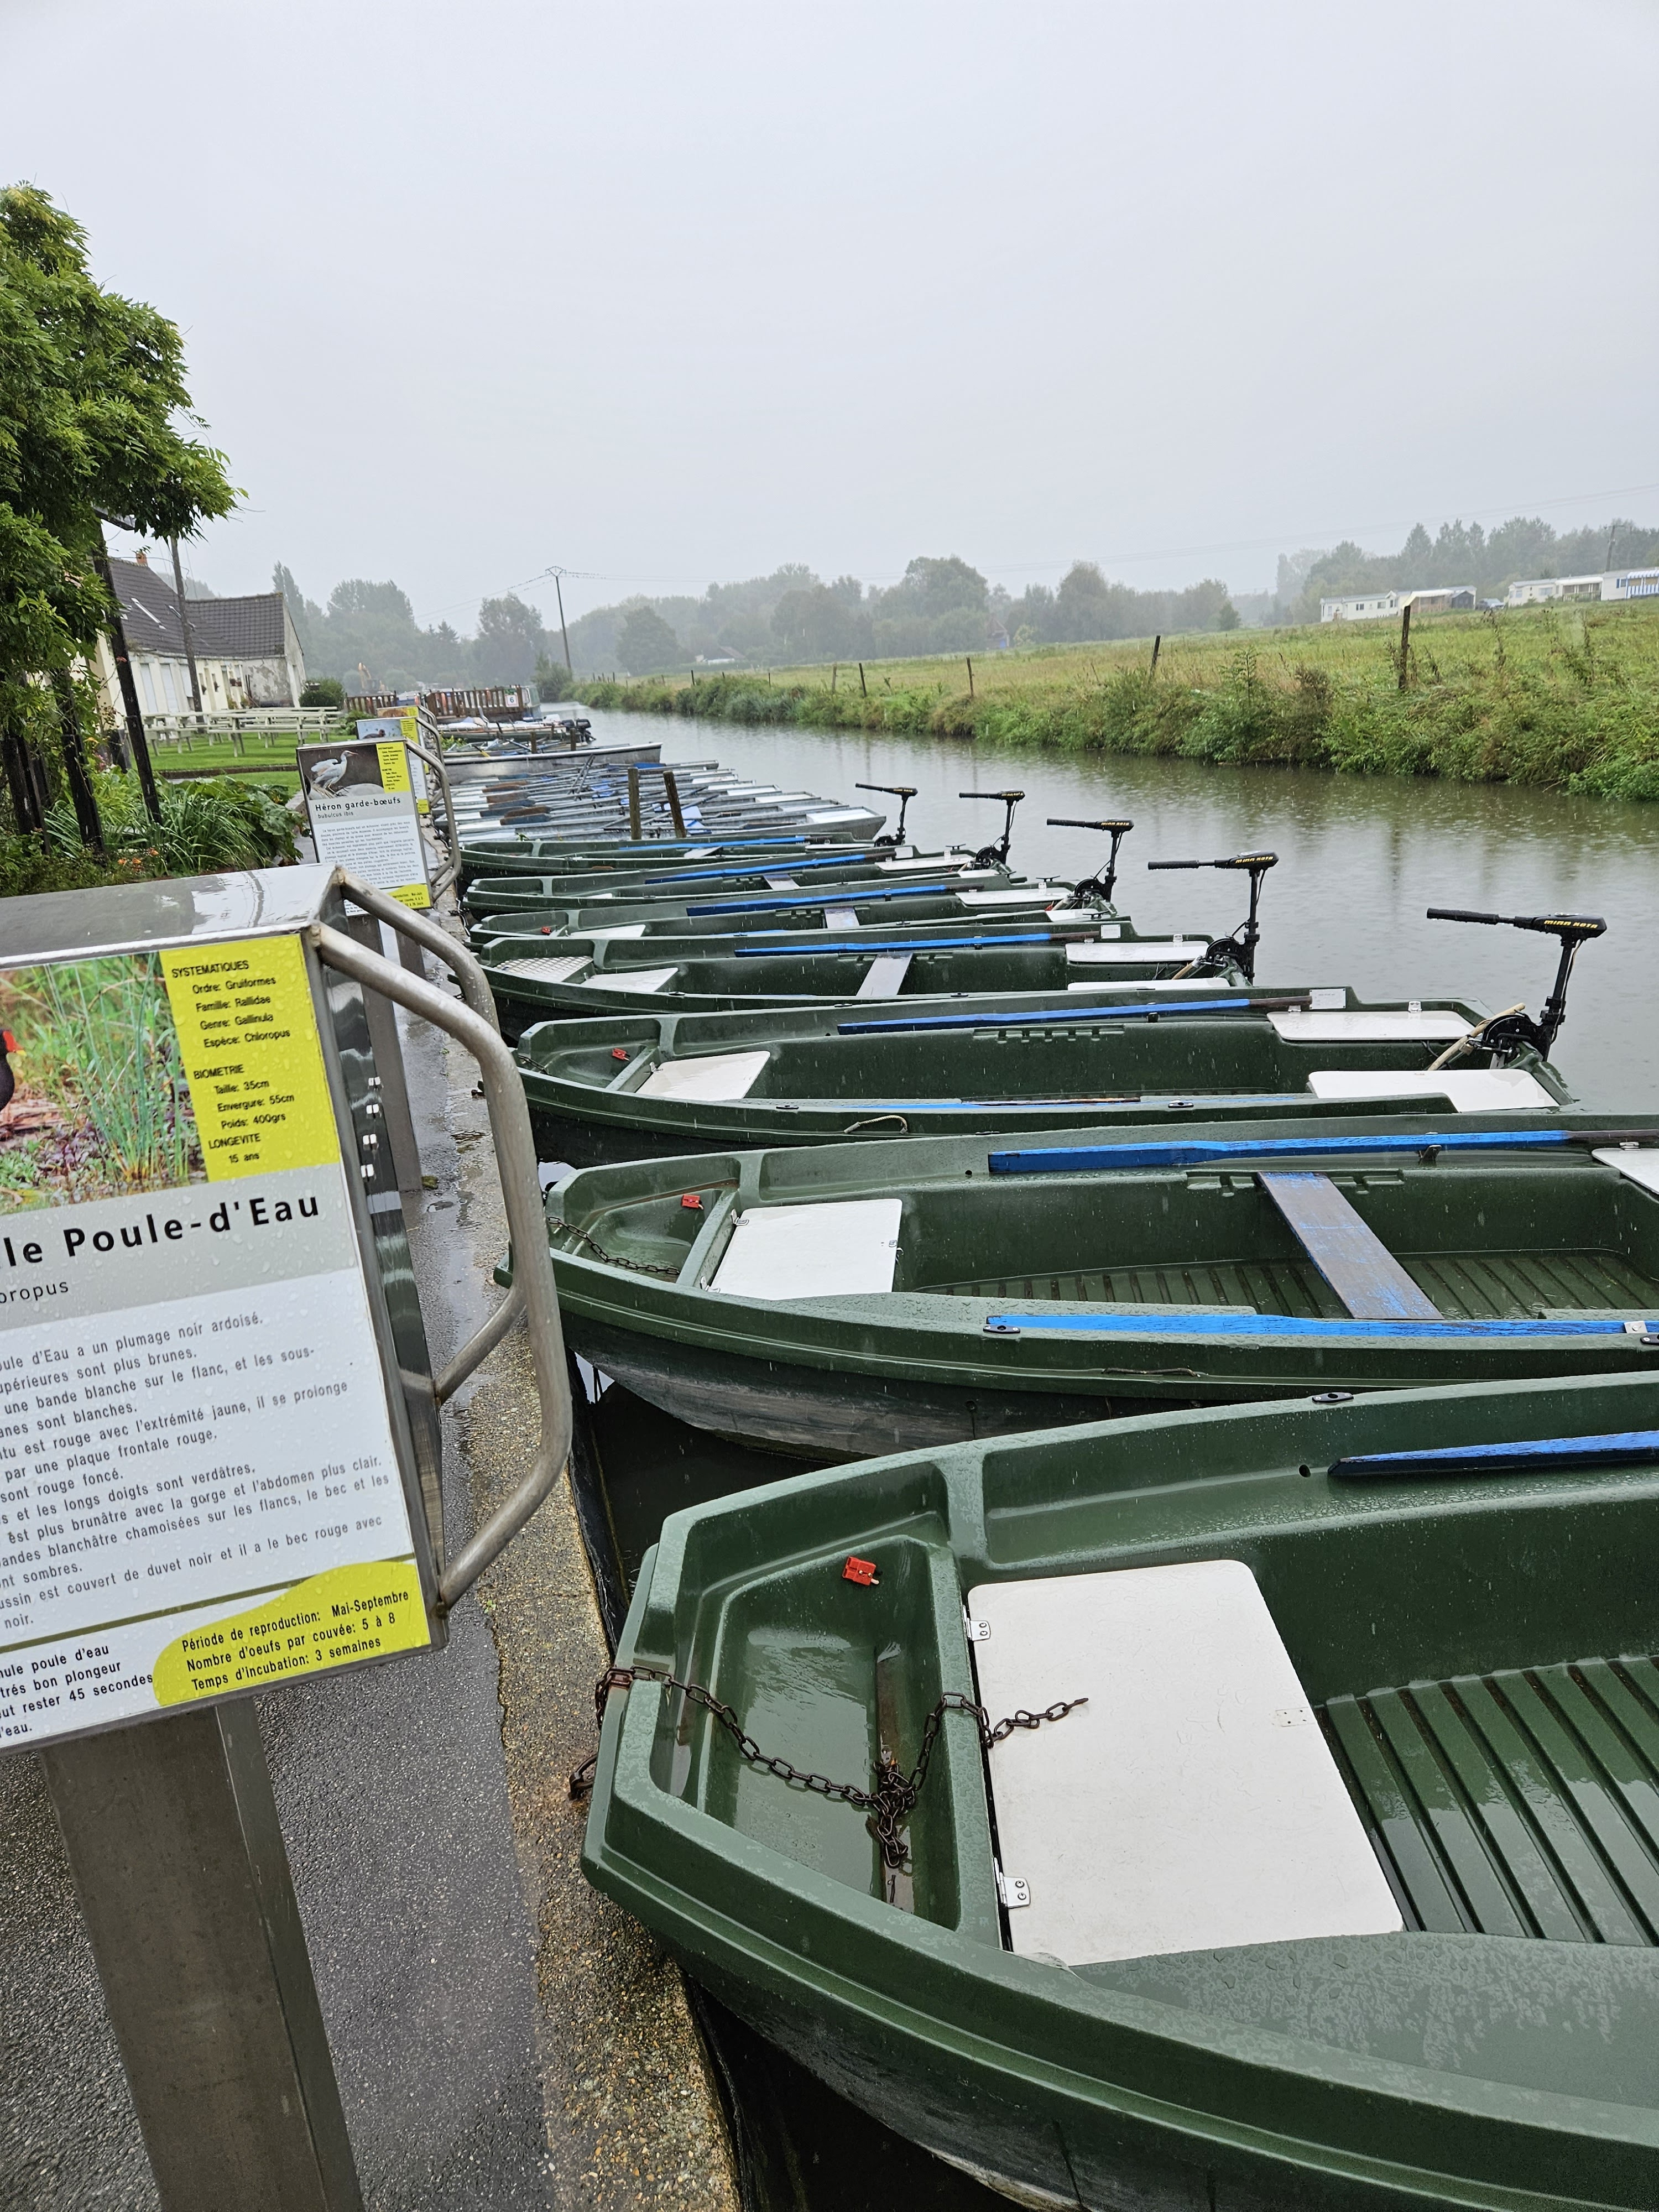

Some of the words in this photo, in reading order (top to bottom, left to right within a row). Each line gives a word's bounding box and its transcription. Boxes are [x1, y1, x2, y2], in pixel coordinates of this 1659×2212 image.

[171, 960, 249, 978] SYSTEMATIQUES
[192, 983, 221, 994] Ordre:
[200, 1020, 231, 1030] Genre:
[204, 1037, 240, 1048] Espèce:
[244, 1030, 290, 1042] Chloropus
[193, 1064, 244, 1079] BIOMETRIE
[213, 1084, 239, 1094] Taille:
[243, 1080, 270, 1091] 35cm
[217, 1099, 264, 1112] Envergure:
[269, 1094, 295, 1104] 55cm
[221, 1119, 248, 1129] Poids:
[253, 1113, 286, 1124] 400grs
[208, 1133, 261, 1149] LONGEVITE
[228, 1154, 239, 1164] 15
[244, 1153, 260, 1161] ans
[77, 1347, 85, 1357] a
[92, 1342, 108, 1354] un
[116, 1331, 170, 1353] plumage
[178, 1322, 202, 1338] noir
[211, 1311, 263, 1332] ardoisé.
[77, 1362, 106, 1379] sont
[113, 1358, 140, 1375] plus
[148, 1349, 197, 1365] brunes.
[4, 1401, 28, 1415] une
[35, 1391, 77, 1408] bande
[84, 1380, 136, 1399] blanche
[144, 1375, 163, 1388] sur
[171, 1370, 184, 1383] le
[191, 1364, 228, 1379] flanc,
[235, 1357, 247, 1371] et
[254, 1354, 273, 1366] les
[280, 1348, 314, 1362] sous-
[24, 1439, 46, 1454] est
[53, 1433, 91, 1449] rouge
[99, 1426, 129, 1440] avec
[212, 1402, 251, 1421] jaune,
[257, 1395, 265, 1409] il
[272, 1394, 286, 1406] se
[294, 1382, 347, 1404] prolonge
[36, 1413, 66, 1431] sont
[73, 1404, 137, 1423] blanches.
[5, 1467, 25, 1483] par
[35, 1461, 59, 1474] une
[66, 1451, 110, 1471] plaque
[118, 1438, 169, 1457] frontale
[177, 1430, 217, 1446] rouge.
[1, 1486, 30, 1503] sont
[37, 1479, 75, 1495] rouge
[82, 1468, 123, 1486] foncé.
[7, 1528, 30, 1544] est
[37, 1524, 64, 1541] plus
[71, 1511, 127, 1531] brunâtre
[135, 1503, 164, 1517] avec
[170, 1498, 182, 1510] la
[190, 1490, 226, 1508] gorge
[234, 1483, 246, 1496] et
[321, 1464, 346, 1481] plus
[353, 1455, 381, 1471] clair.
[17, 1507, 30, 1521] et
[36, 1505, 57, 1517] les
[64, 1495, 100, 1511] longs
[108, 1484, 148, 1502] doigts
[156, 1475, 184, 1492] sont
[191, 1464, 255, 1485] verdâtres.
[0, 1550, 41, 1567] andes
[48, 1534, 117, 1557] blanchâtre
[126, 1516, 200, 1540] chamoisées
[207, 1510, 226, 1522] sur
[233, 1505, 252, 1517] les
[259, 1495, 301, 1511] flancs,
[306, 1489, 318, 1501] le
[325, 1484, 347, 1497] bec
[354, 1477, 365, 1491] et
[371, 1475, 389, 1487] les
[39, 1585, 60, 1600] est
[67, 1573, 116, 1594] couvert
[124, 1569, 139, 1582] de
[147, 1558, 181, 1576] duvet
[189, 1552, 212, 1567] noir
[221, 1547, 232, 1560] et
[239, 1543, 247, 1556] il
[254, 1543, 261, 1553] a
[267, 1538, 279, 1550] le
[285, 1533, 308, 1546] bec
[315, 1524, 348, 1540] rouge
[356, 1517, 382, 1530] avec
[0, 1574, 15, 1588] nt
[23, 1563, 82, 1583] sombres.
[4, 1613, 33, 1629] noir.
[182, 1632, 224, 1652] Période
[231, 1628, 243, 1641] de
[249, 1611, 320, 1637] reproduction:
[331, 1591, 409, 1618] Mai-Septembre
[186, 1653, 232, 1672] Nombre
[287, 1635, 305, 1651] par
[313, 1624, 356, 1642] couvée:
[362, 1618, 369, 1630] 5
[375, 1615, 382, 1627] à
[388, 1612, 395, 1624] 8
[31, 1654, 67, 1674] poule
[33, 1677, 58, 1691] bon
[65, 1662, 121, 1686] plongeur
[191, 1674, 228, 1691] Temps
[315, 1649, 322, 1661] 3
[329, 1638, 381, 1658] semaines
[0, 1705, 15, 1719] ut
[23, 1696, 60, 1713] rester
[69, 1688, 85, 1701] 45
[93, 1674, 153, 1696] secondes
